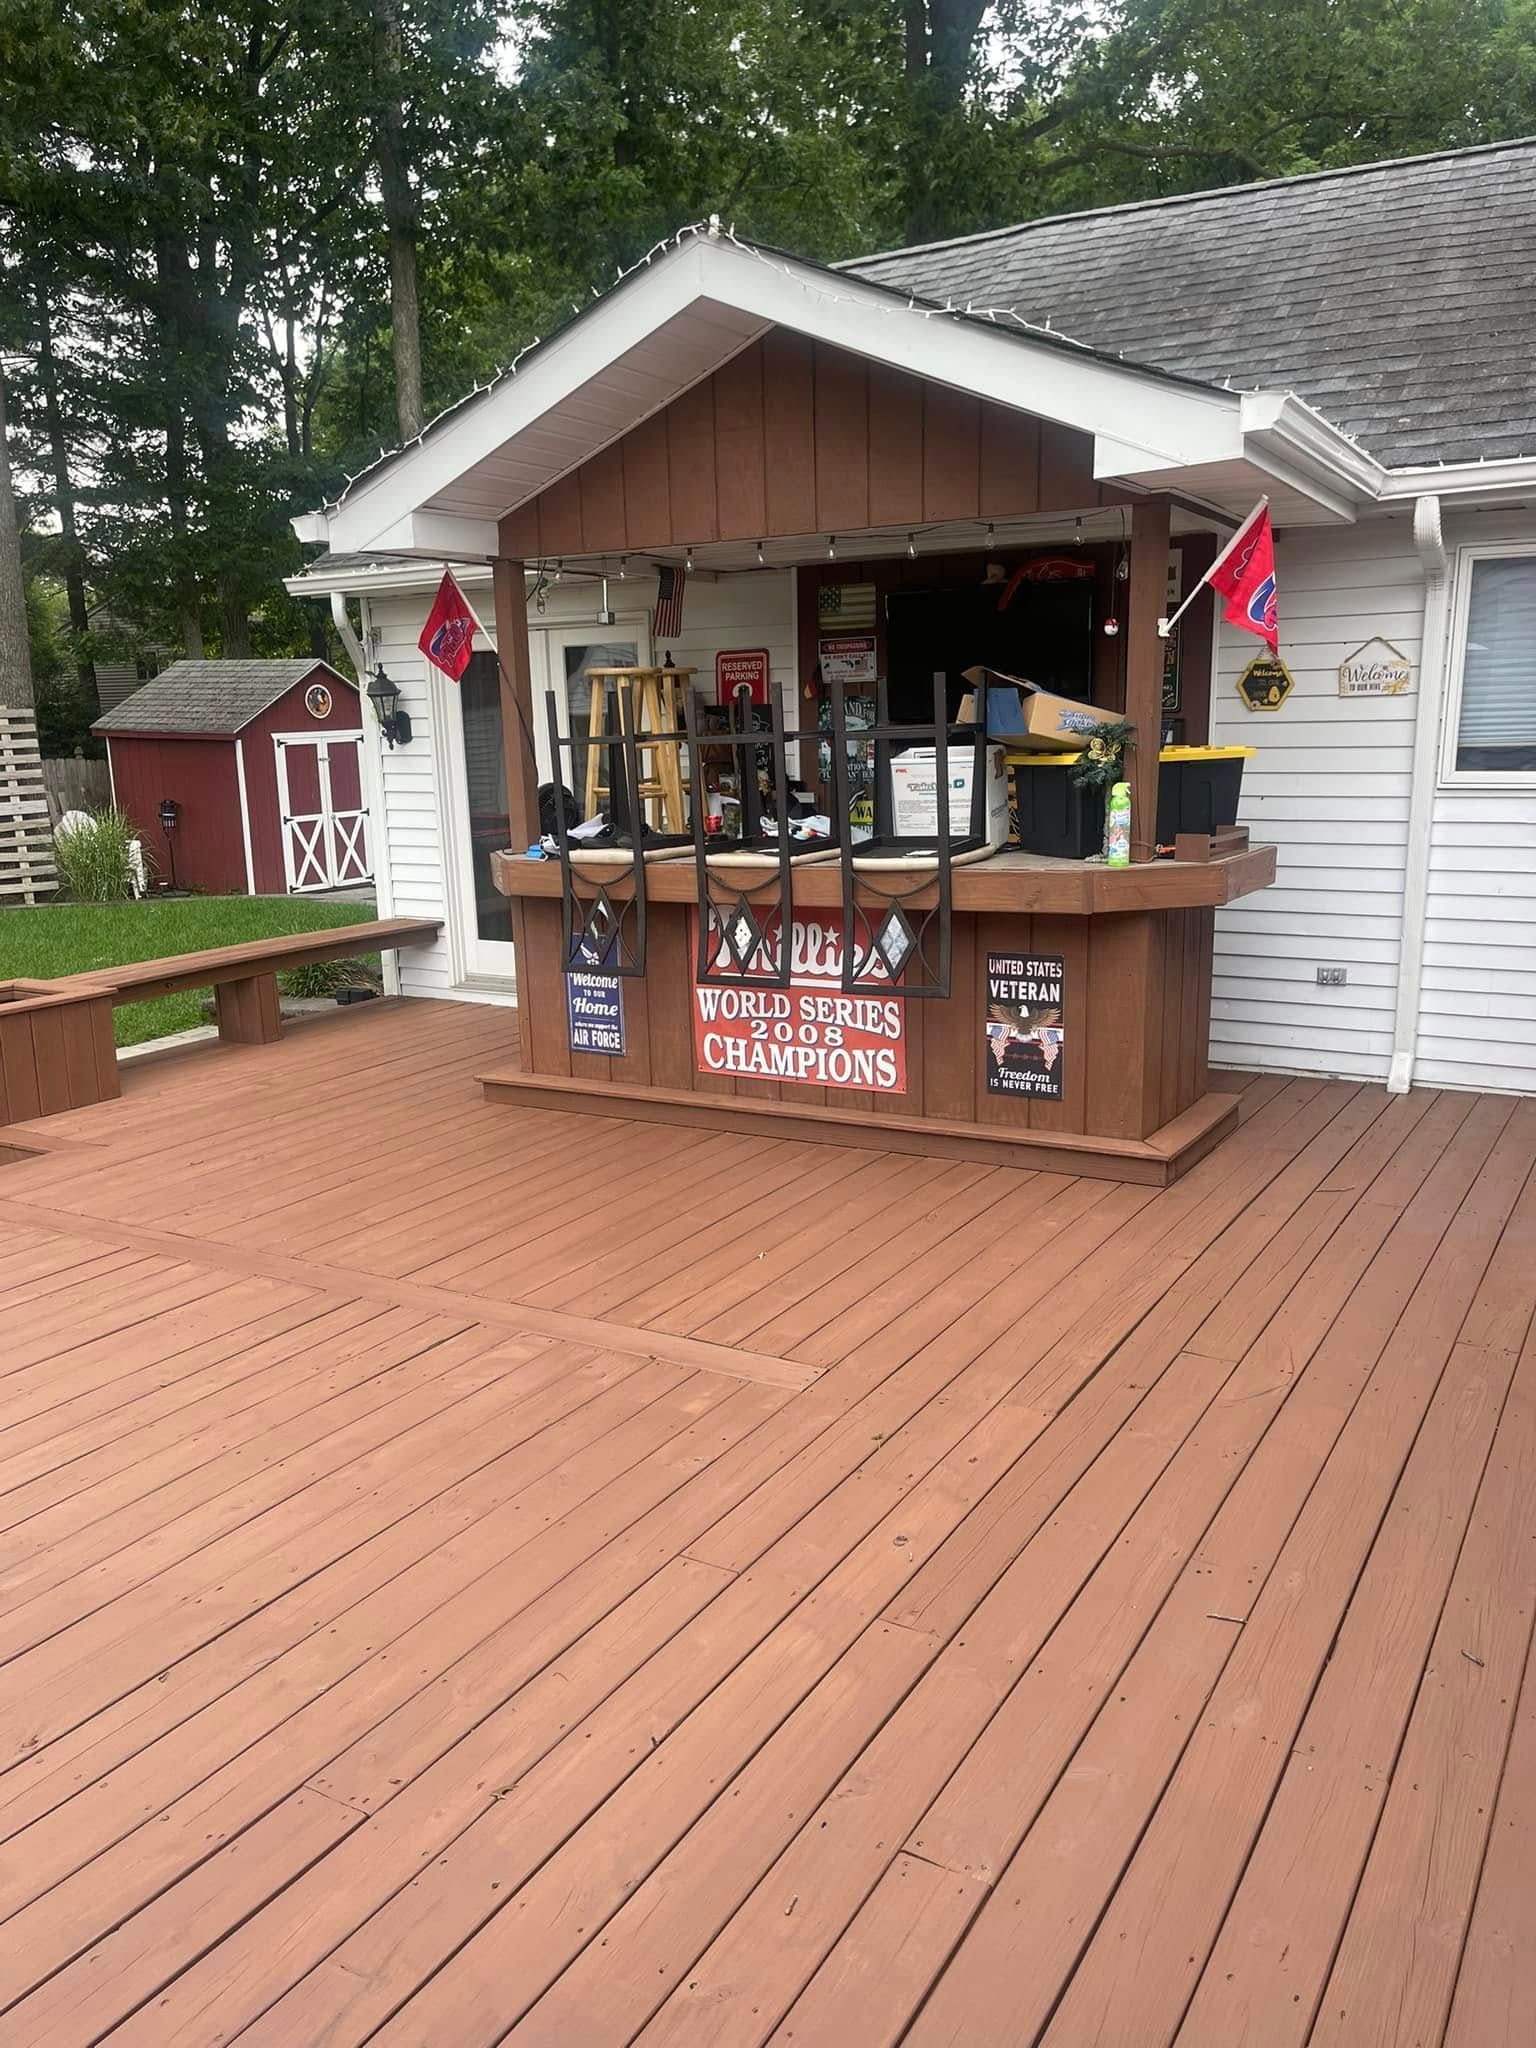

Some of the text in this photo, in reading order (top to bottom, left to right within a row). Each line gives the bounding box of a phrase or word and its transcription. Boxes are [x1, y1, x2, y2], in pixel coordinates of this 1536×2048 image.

[721, 661, 762, 672] RESERVED
[725, 671, 759, 681] PARKING
[1343, 663, 1405, 682] Welcome
[988, 958, 1062, 978] UNITED STATES
[569, 972, 618, 989] Welcome
[584, 989, 606, 998] TO OUR
[989, 979, 1060, 1002] VETERAN
[573, 997, 618, 1016] Home
[696, 986, 901, 1040] WORLD SERIES
[574, 1029, 621, 1049] AIR FORCE
[750, 1020, 844, 1047] 2008
[703, 1032, 898, 1088] CHAMPIONS
[998, 1066, 1050, 1083] Freedom
[990, 1078, 1058, 1094] IS NEVER FREE
